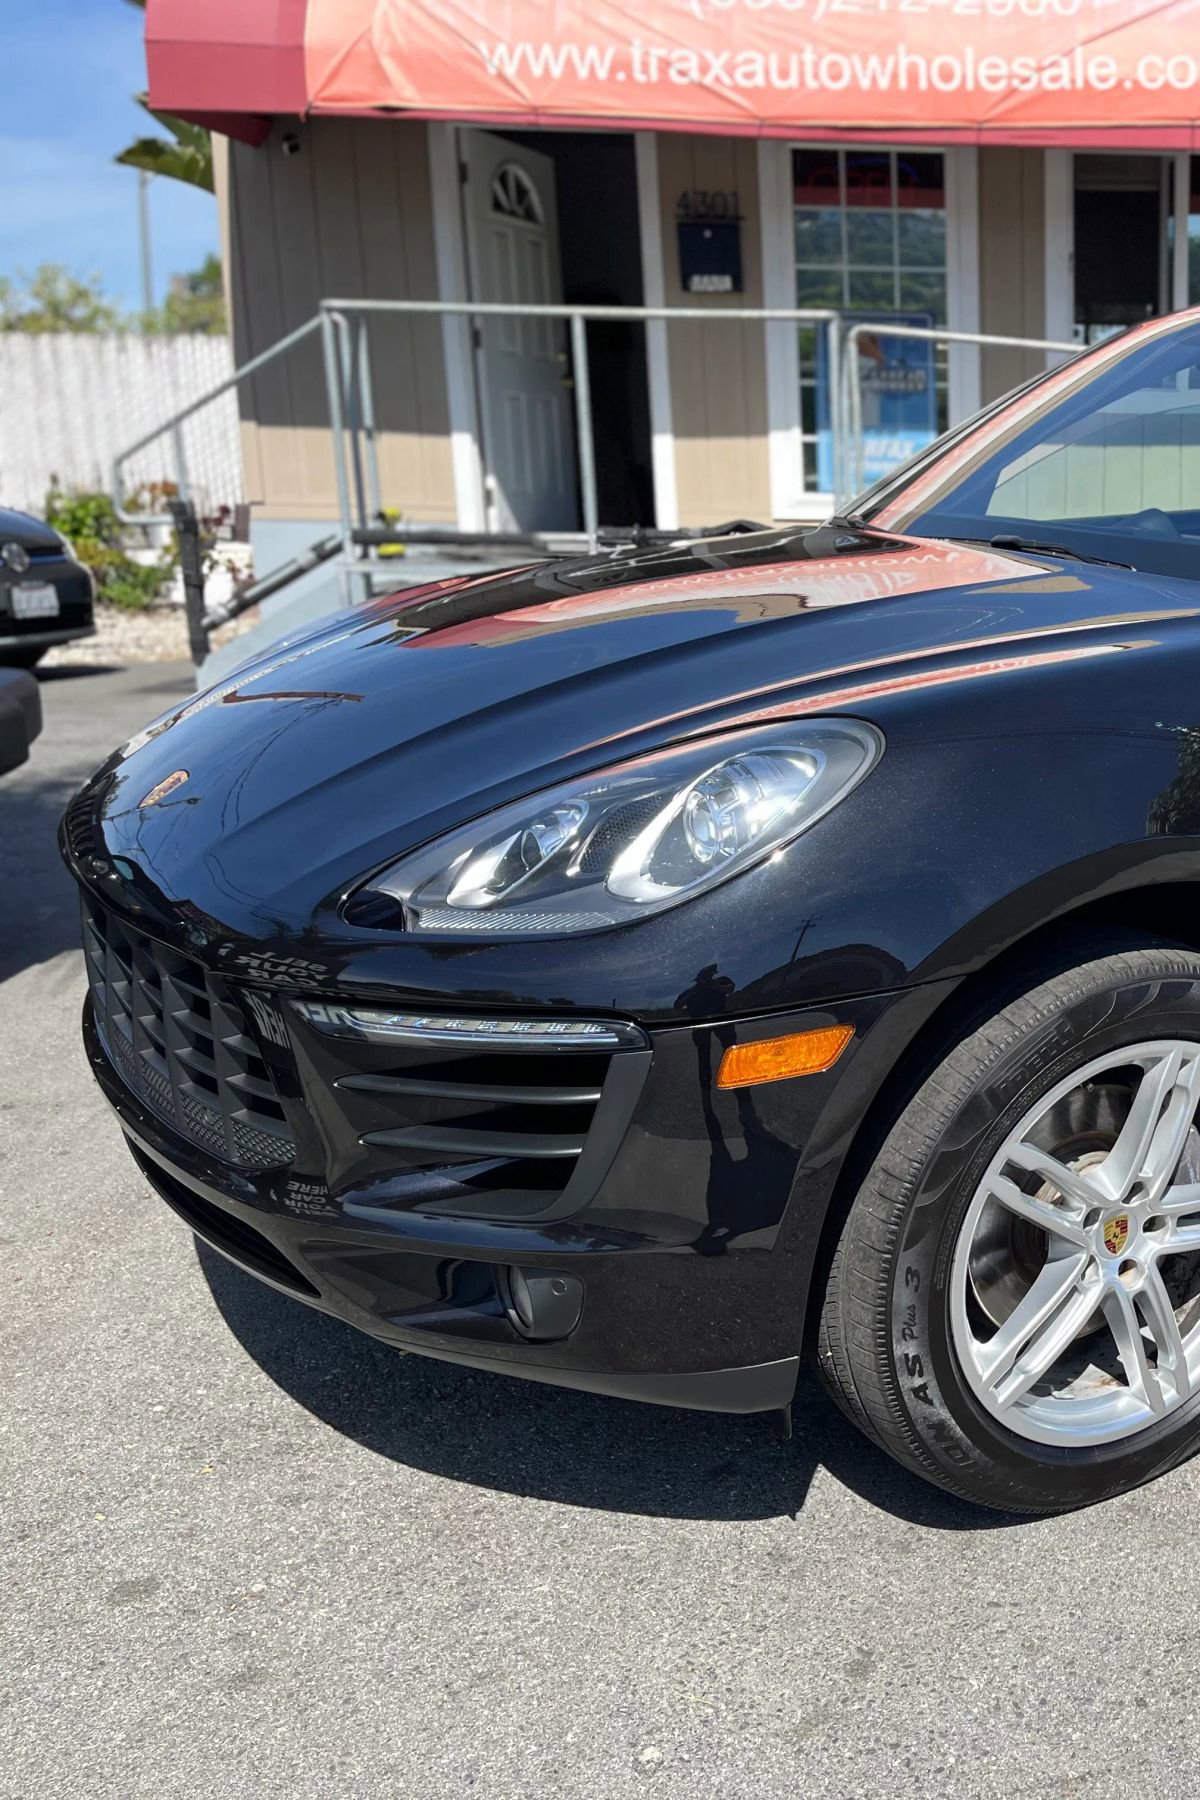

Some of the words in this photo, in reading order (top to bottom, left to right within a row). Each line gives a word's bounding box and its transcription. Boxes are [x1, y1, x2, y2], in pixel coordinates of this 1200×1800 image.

[676, 190, 740, 218] 4301
[904, 1265, 921, 1294] 3
[902, 1303, 918, 1343] Plus
